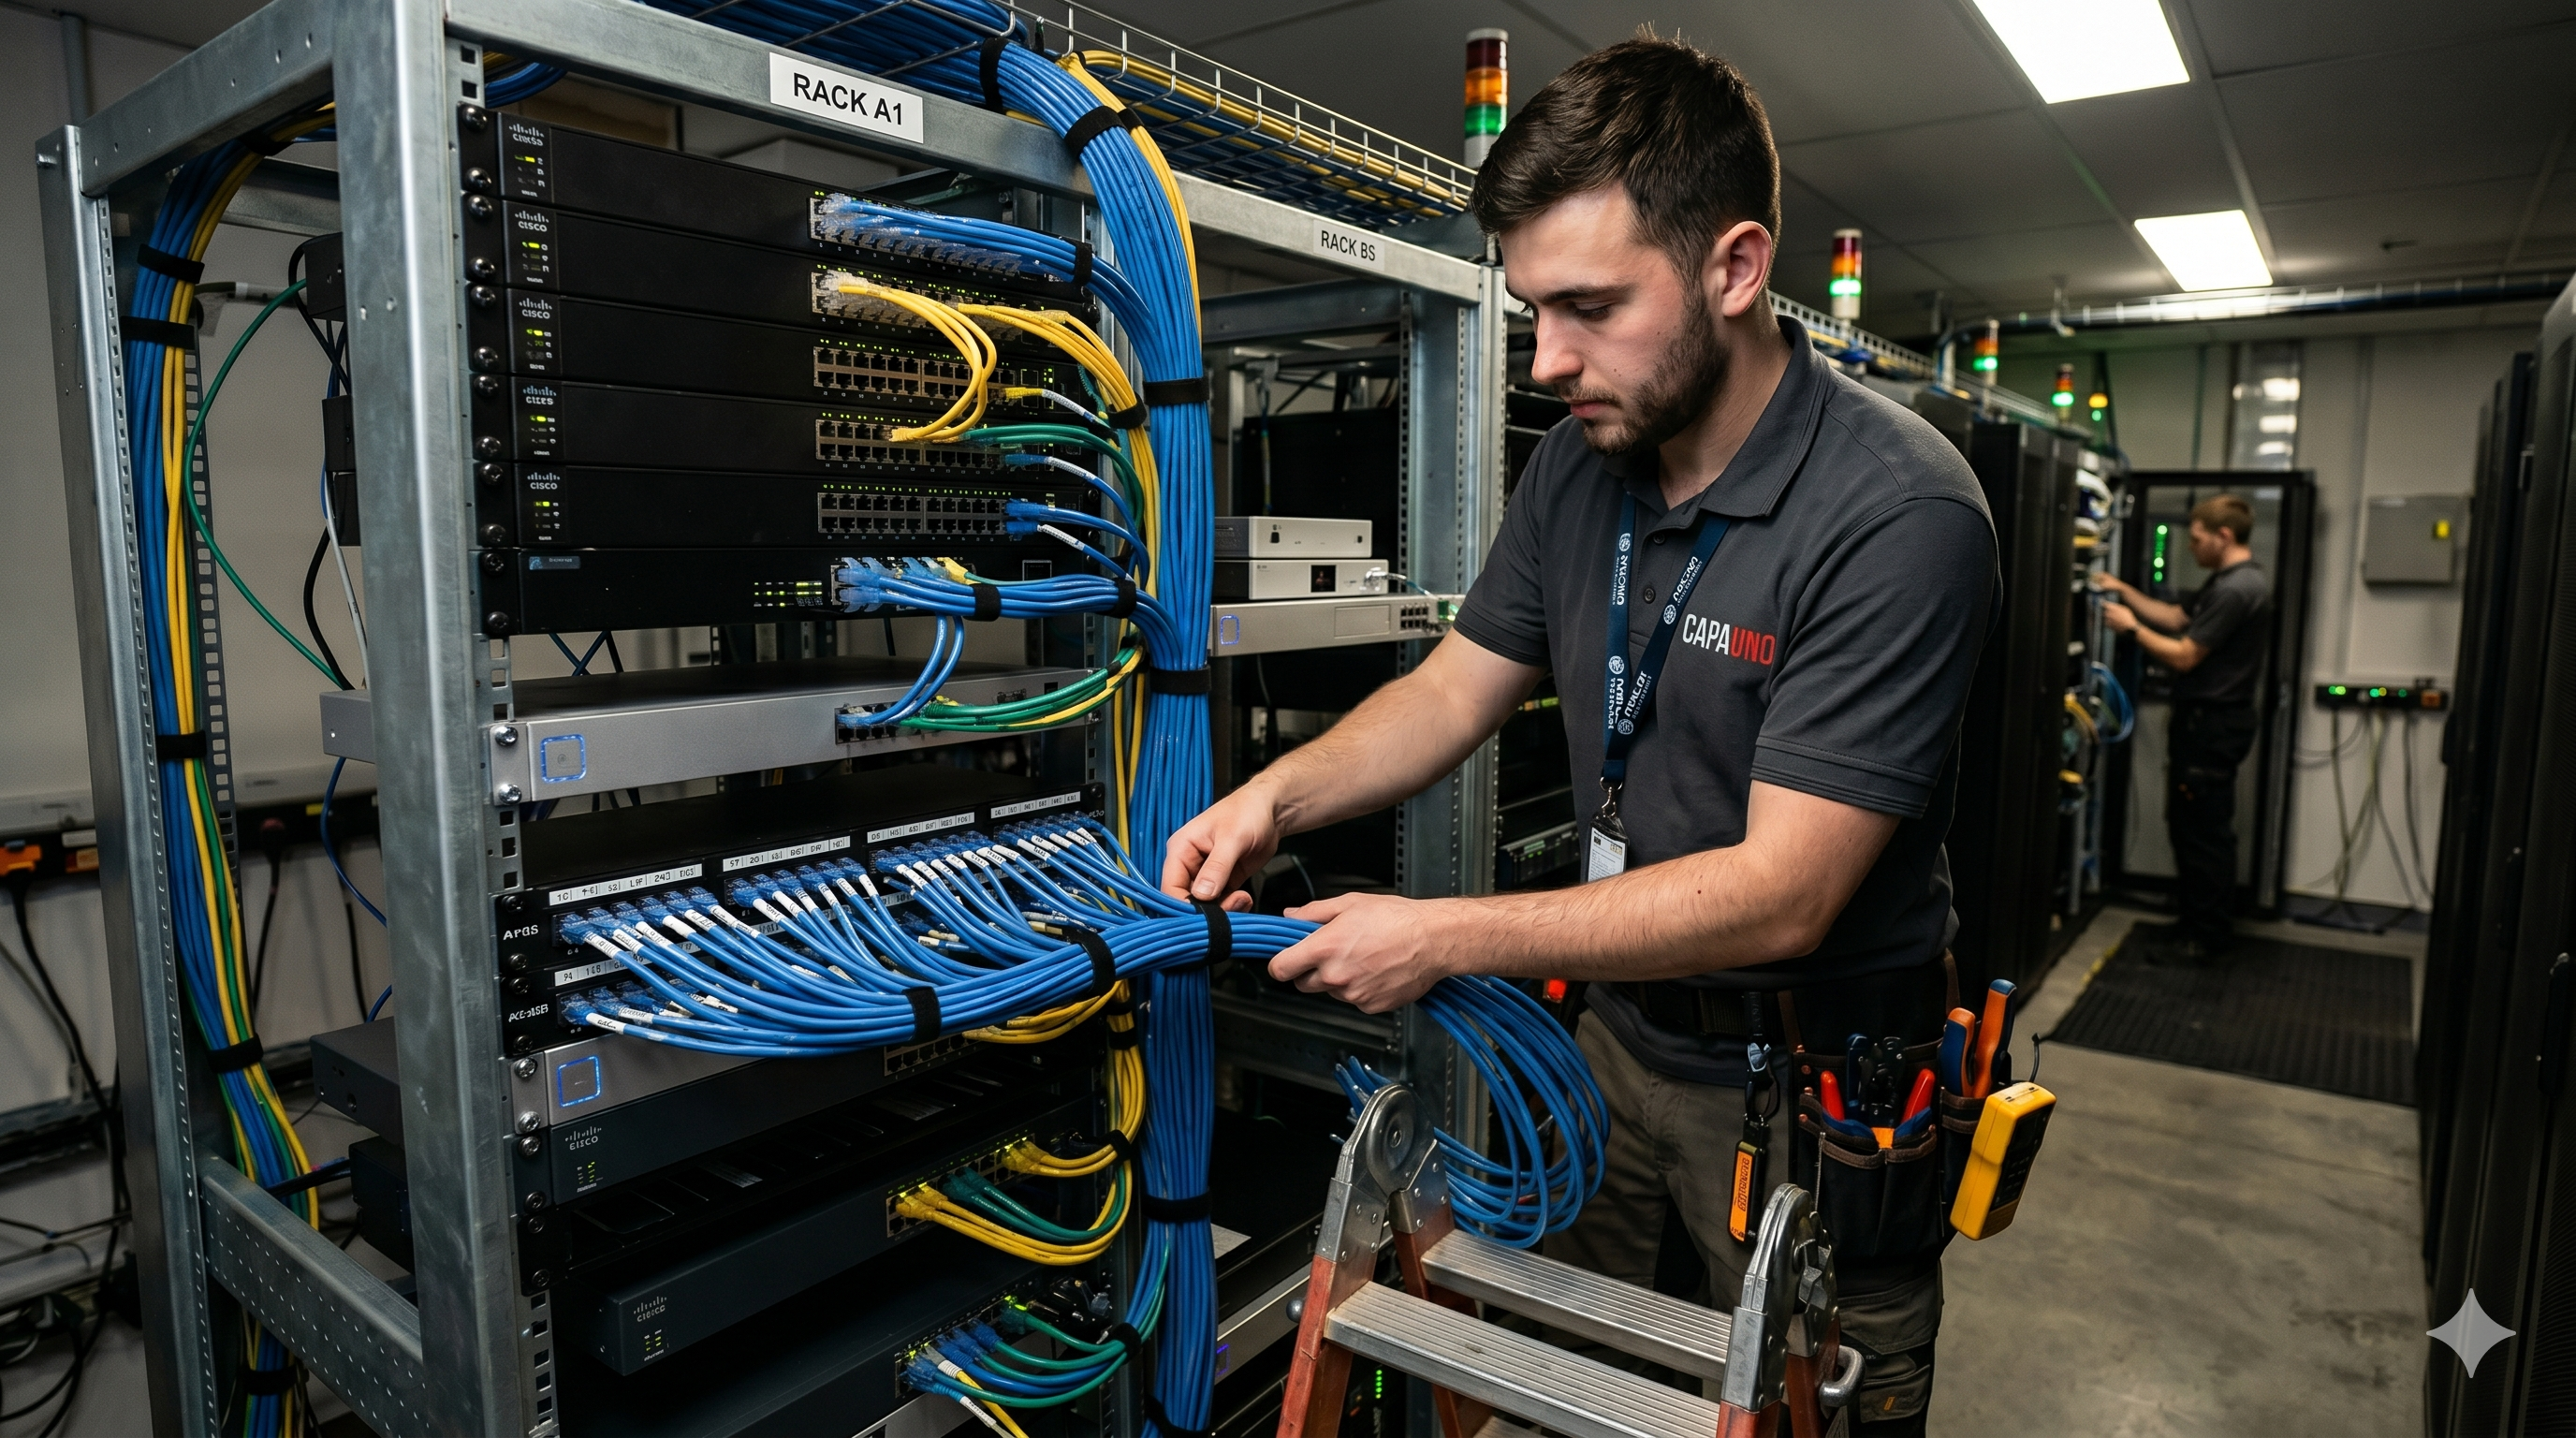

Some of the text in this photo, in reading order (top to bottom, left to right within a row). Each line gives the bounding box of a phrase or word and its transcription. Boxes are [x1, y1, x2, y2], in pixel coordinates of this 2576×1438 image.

[794, 72, 902, 125] RACK A1
[1321, 230, 1357, 257] RACK
[1682, 613, 1776, 666] CAPAUNO
